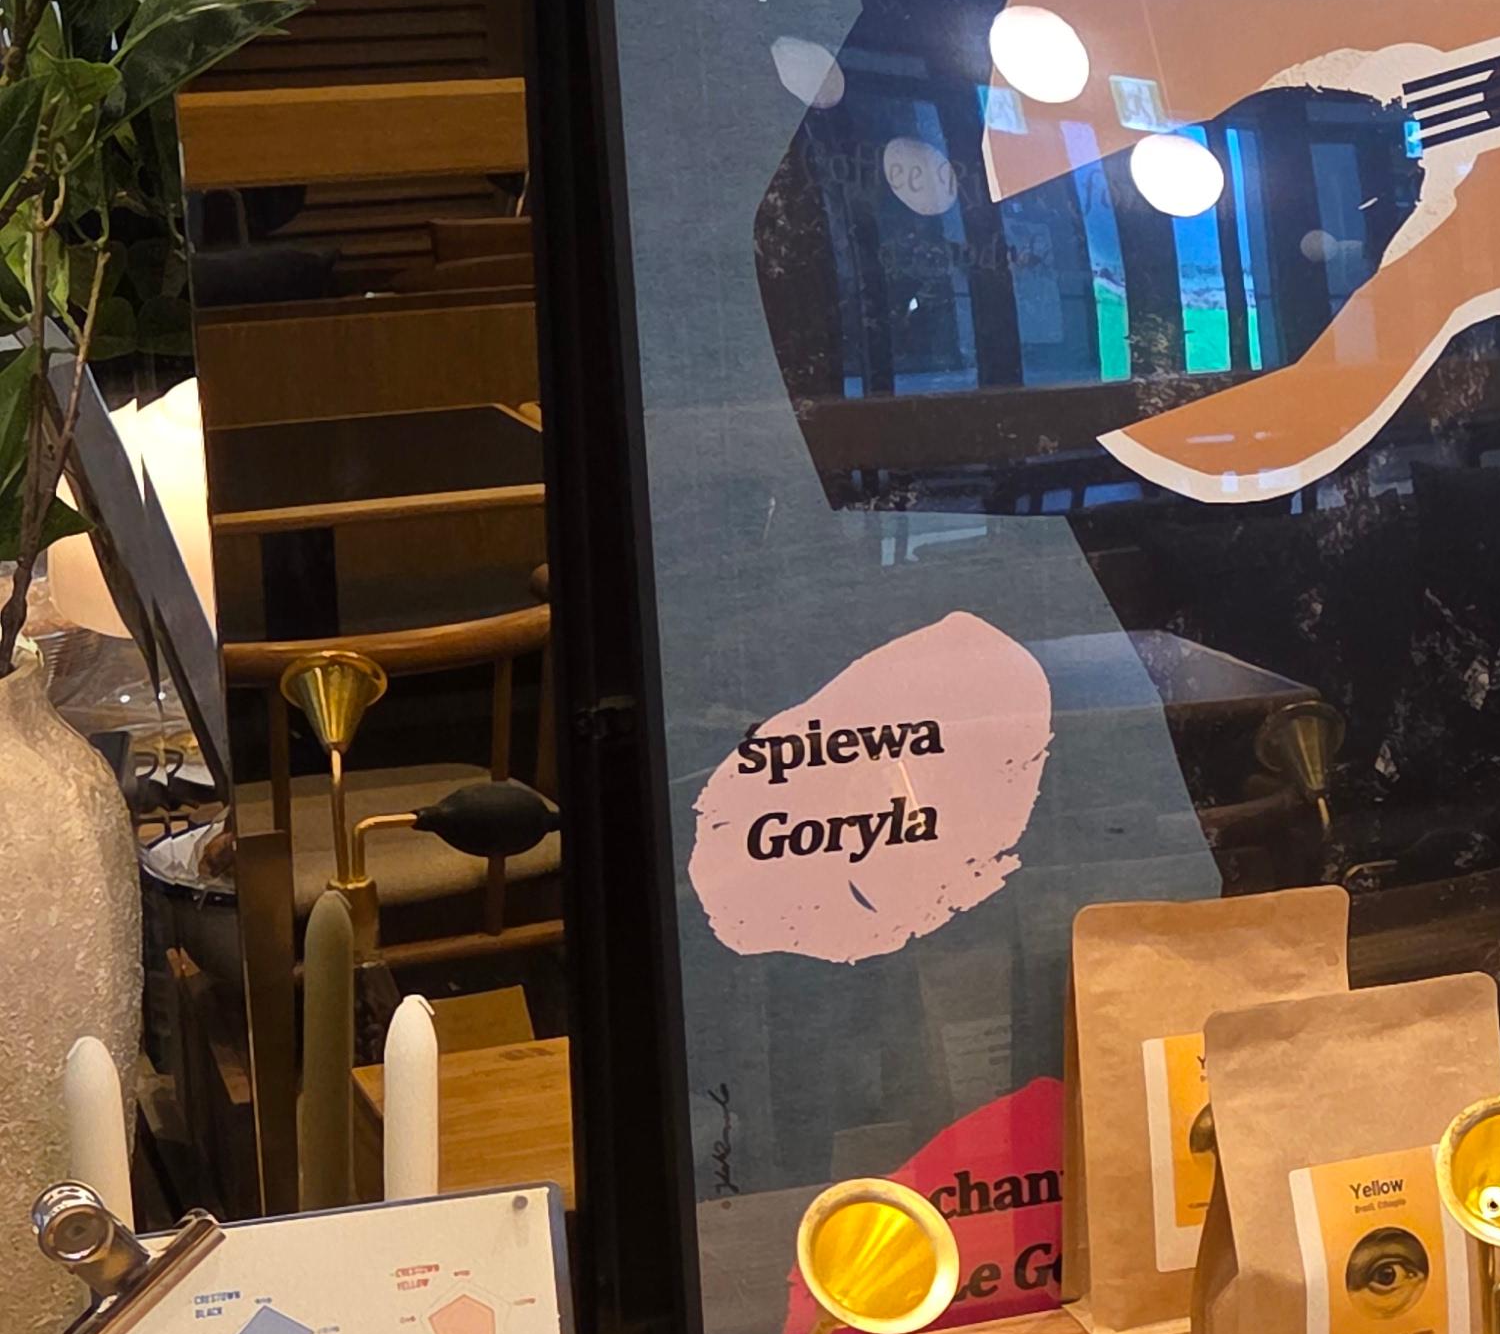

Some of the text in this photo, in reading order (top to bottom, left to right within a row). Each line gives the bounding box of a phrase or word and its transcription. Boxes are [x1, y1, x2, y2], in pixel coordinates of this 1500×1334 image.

[737, 719, 945, 785] śpiewa
[746, 796, 938, 864] Goryla
[929, 1170, 1063, 1220] chan
[1349, 1179, 1404, 1199] Yellow
